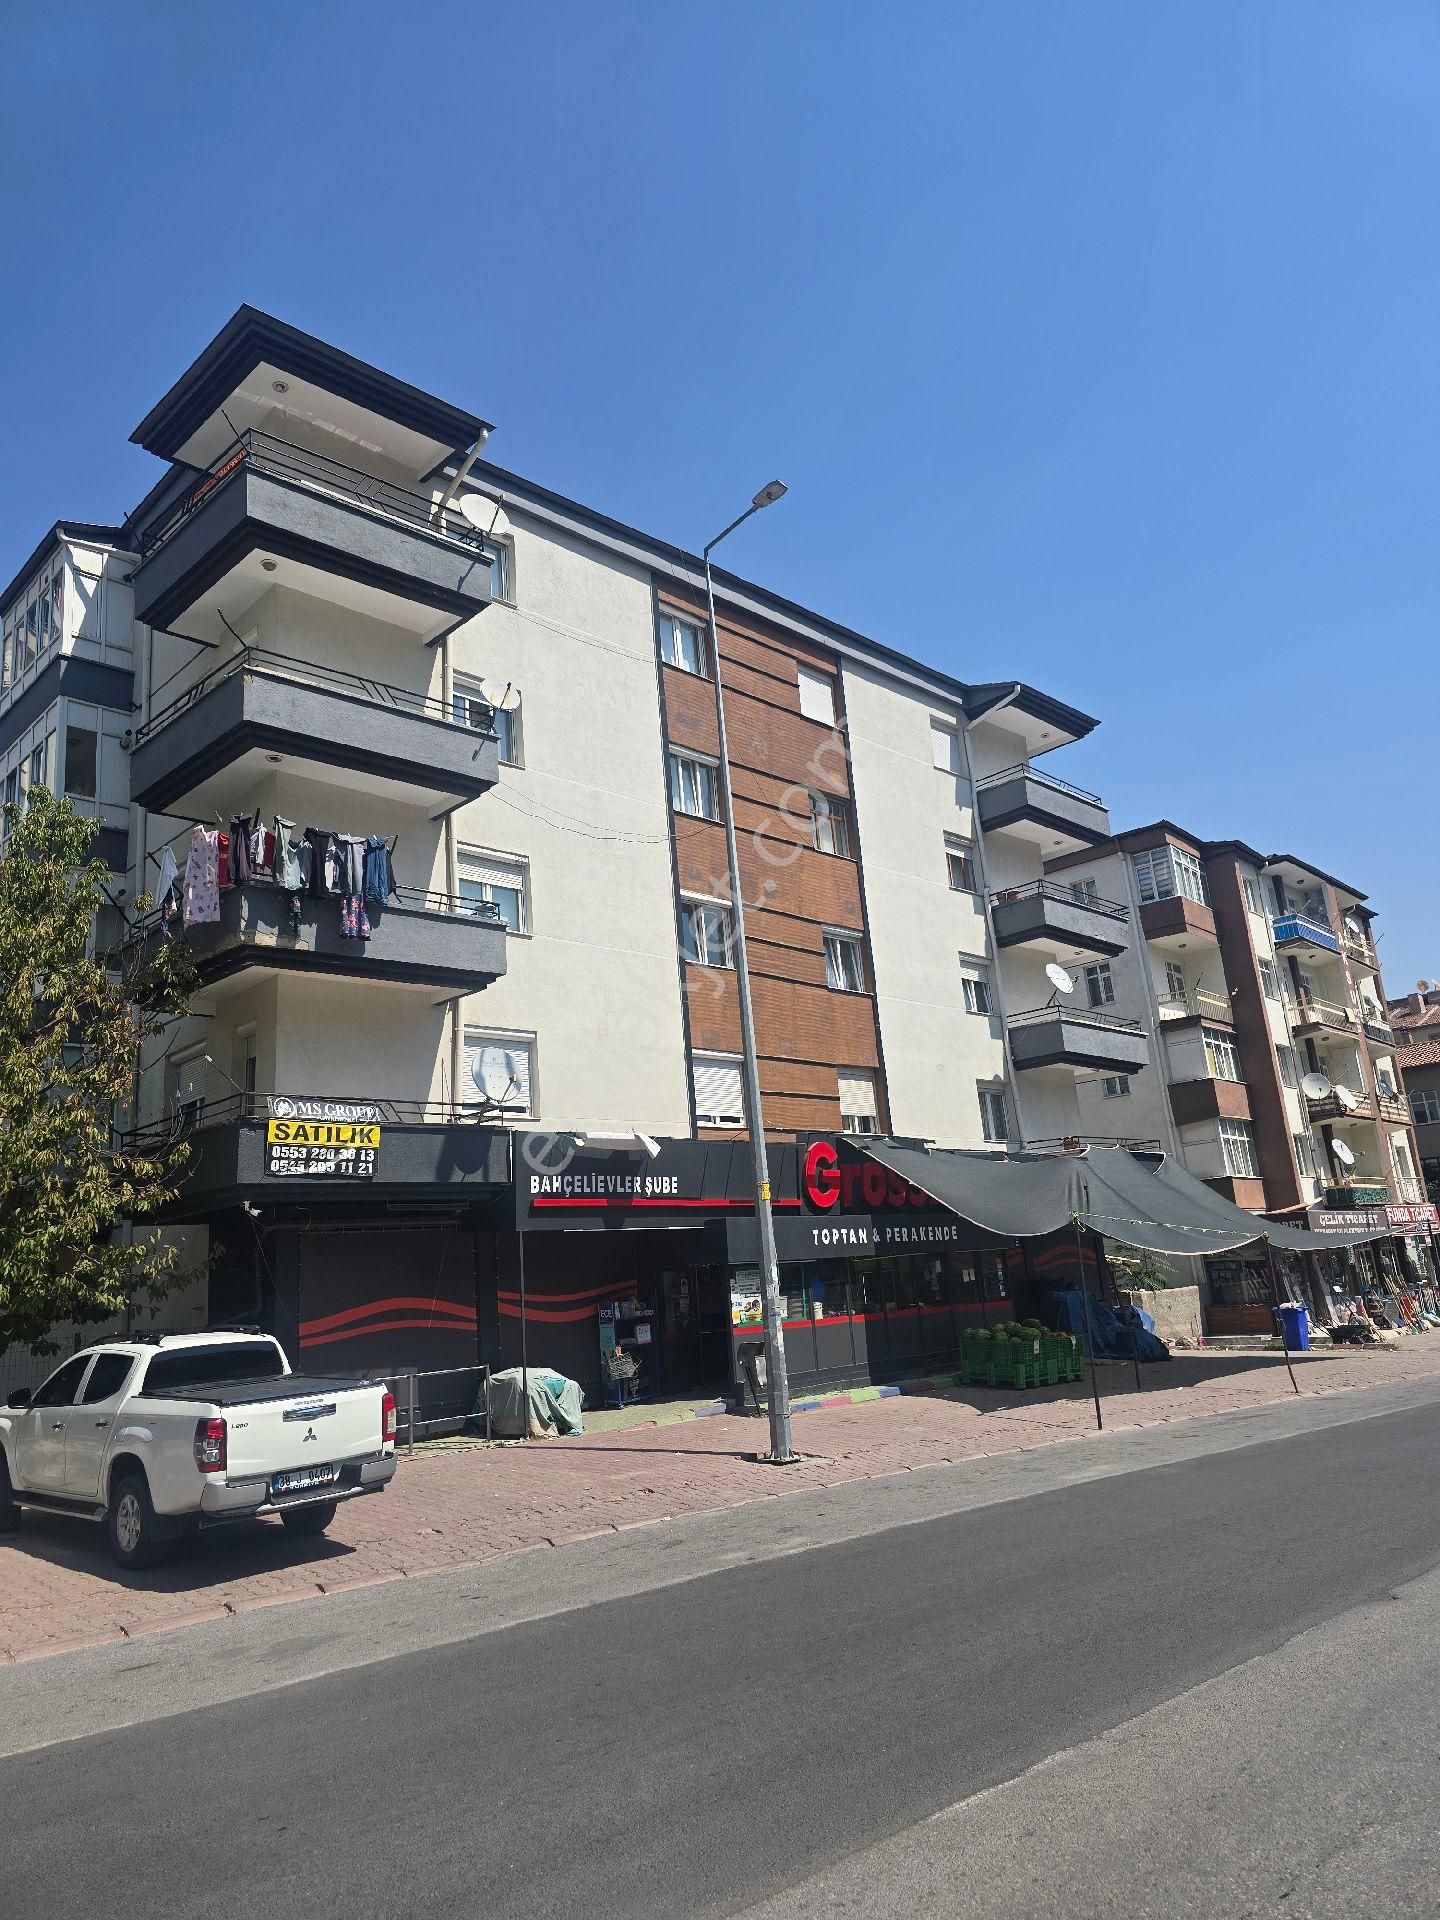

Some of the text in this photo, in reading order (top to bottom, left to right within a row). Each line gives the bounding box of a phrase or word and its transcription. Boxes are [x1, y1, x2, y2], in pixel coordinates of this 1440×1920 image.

[298, 1102, 322, 1115] MS
[274, 1123, 374, 1144] SATILIK
[272, 1146, 307, 1159] 0553
[360, 1149, 375, 1161] 13
[357, 1162, 373, 1174] 21
[530, 1172, 678, 1198] BAHÇELİEVLER ŞUBE
[812, 1226, 958, 1245] TOPTAN & PERAKENDE
[278, 1466, 331, 1488] 38 J 0407
